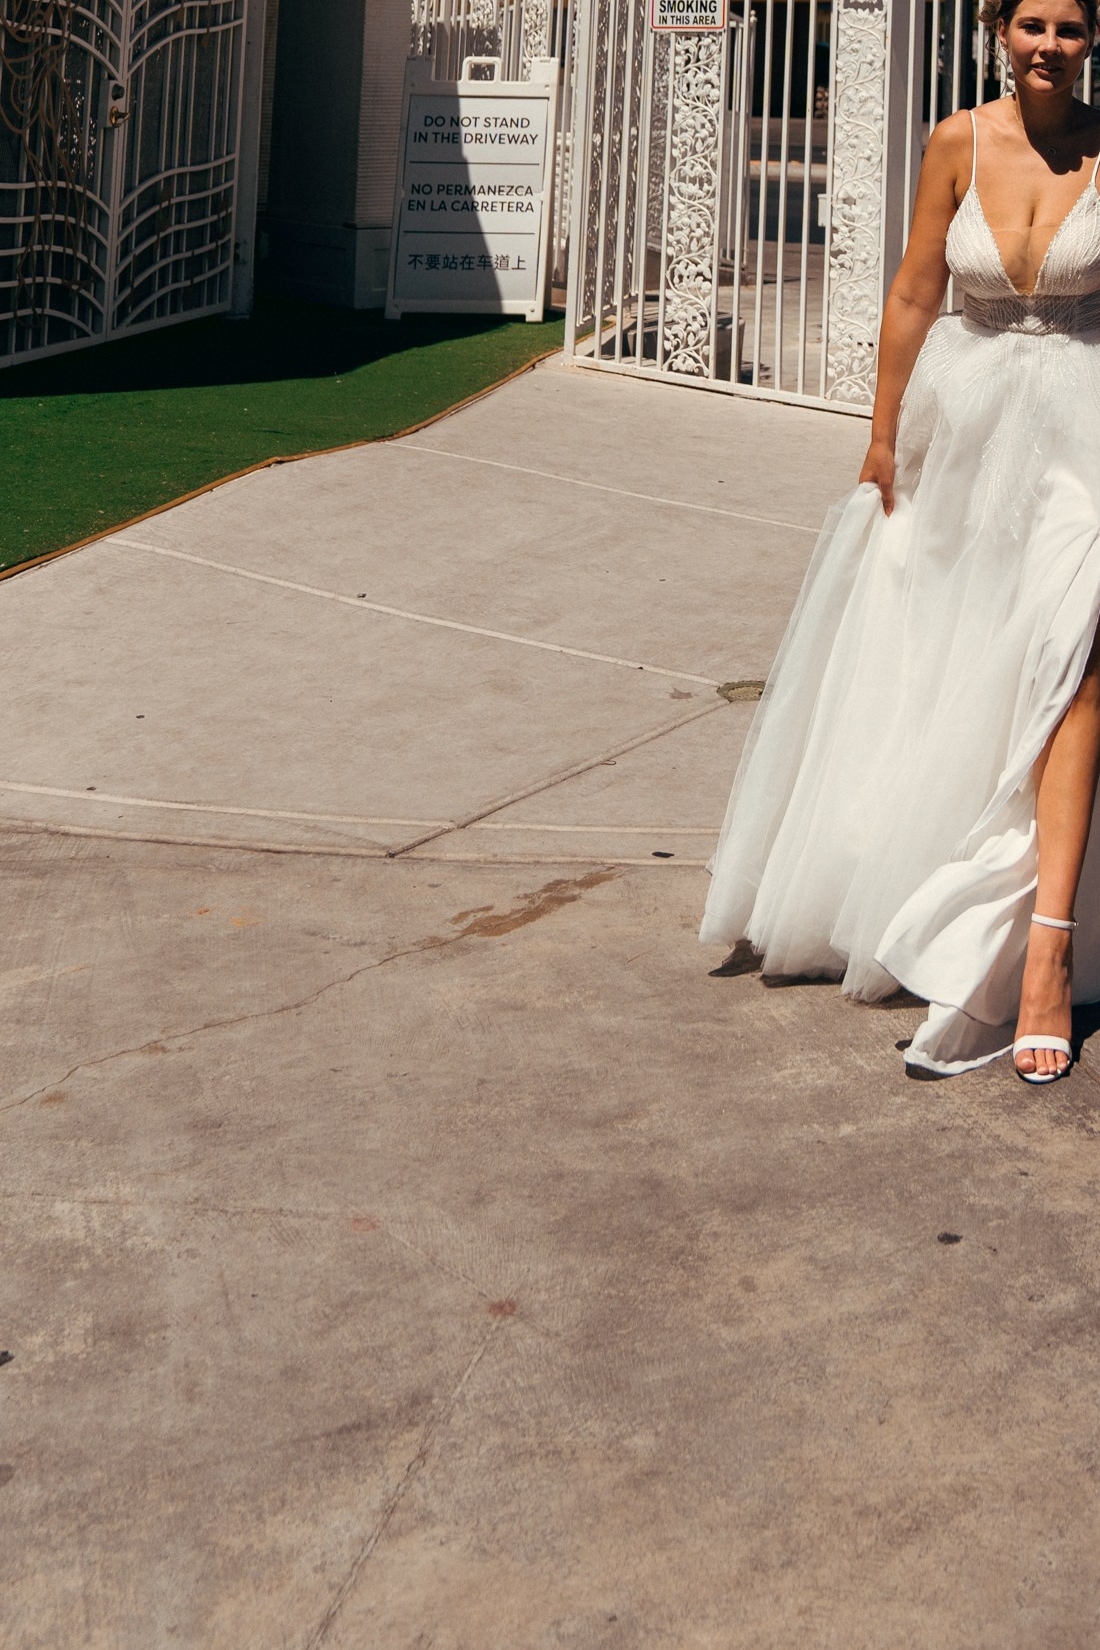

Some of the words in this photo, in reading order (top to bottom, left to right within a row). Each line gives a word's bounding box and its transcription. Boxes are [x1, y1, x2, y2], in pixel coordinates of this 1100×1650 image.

[659, 0, 717, 14] SMOKING
[658, 15, 668, 25] IN
[670, 15, 690, 25] THIS
[692, 15, 717, 25] AREA
[423, 115, 446, 128] DO
[449, 116, 480, 128] NOT
[483, 116, 531, 129] STAND
[413, 131, 429, 144] IN
[432, 131, 460, 144] THE
[463, 132, 539, 145] DRIVEWAY
[410, 183, 433, 196] NO
[436, 183, 534, 197] PERMANEZCA
[407, 199, 427, 212] EN
[430, 199, 448, 212] LA
[450, 200, 535, 213] CARRETERA
[407, 253, 527, 272] 不要站在车道上
